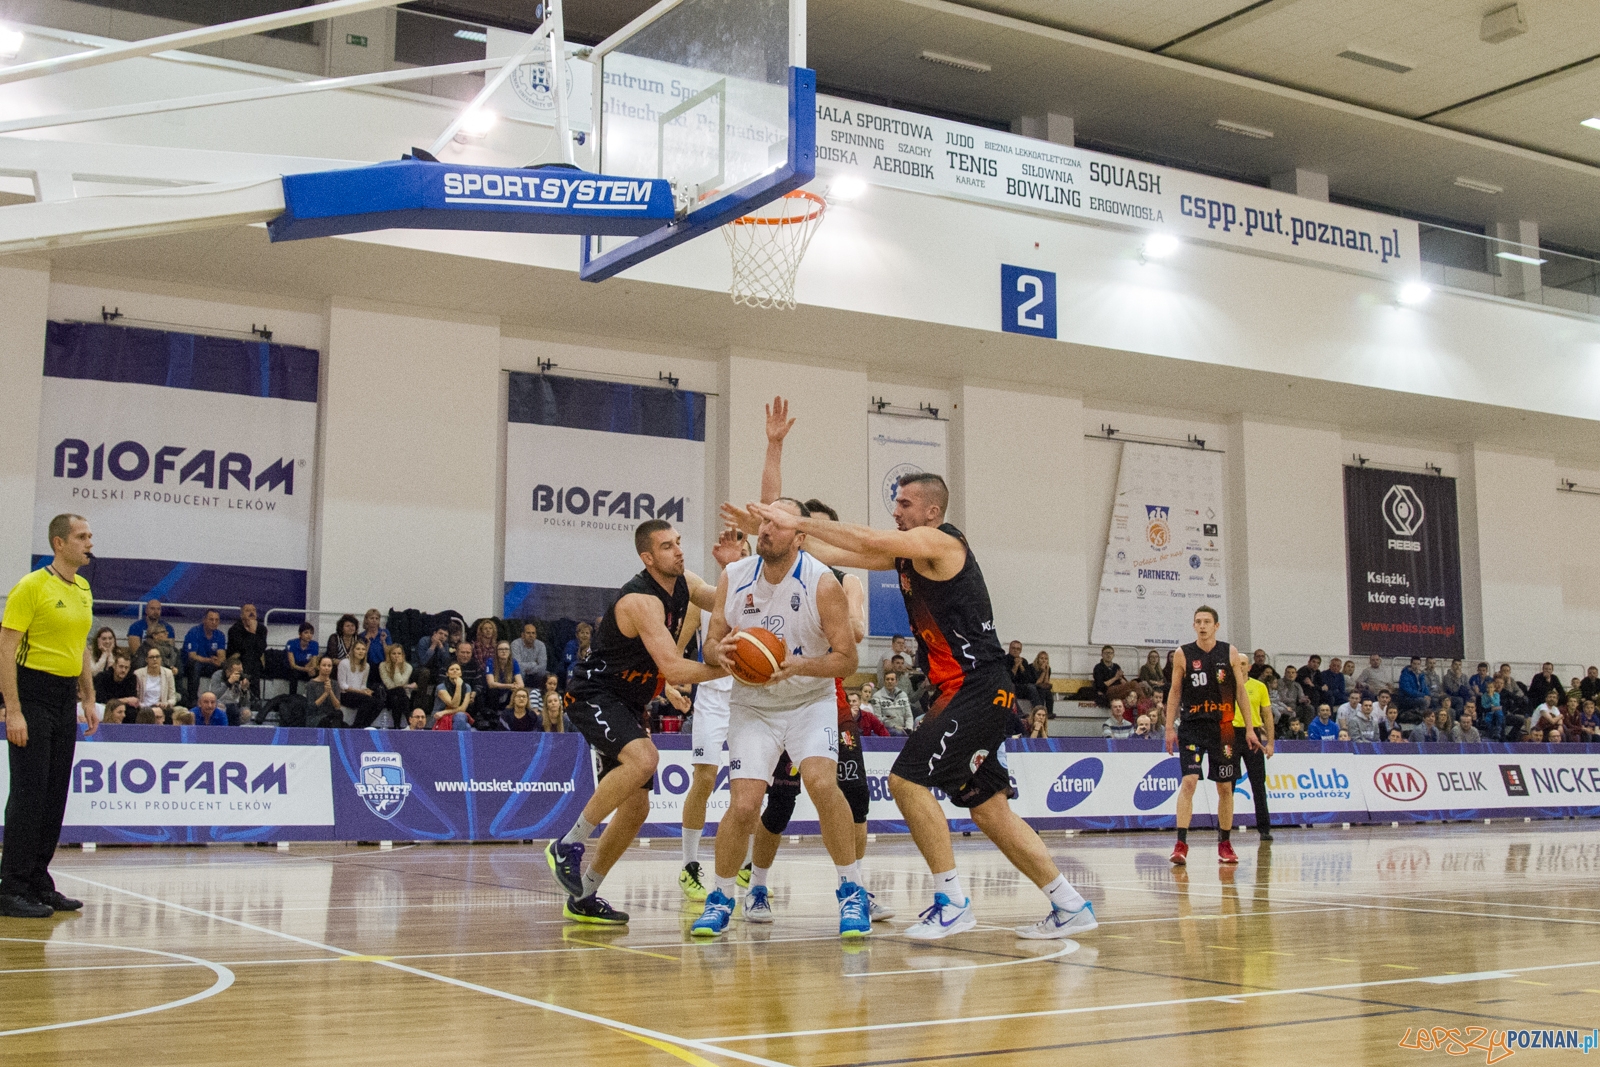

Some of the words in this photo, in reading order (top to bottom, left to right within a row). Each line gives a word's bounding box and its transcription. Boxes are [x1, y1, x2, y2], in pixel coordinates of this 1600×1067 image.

[603, 72, 664, 94] entrum
[816, 105, 852, 125] HALA
[856, 113, 933, 141] SPORTOWA
[831, 130, 884, 150] SPININNG
[898, 143, 932, 157] SZACHY
[945, 132, 974, 149] JUDO
[873, 156, 934, 179] AEROBIK
[946, 151, 997, 177] TENIS
[1015, 148, 1081, 168] LEKKOATLETYCZNA
[956, 175, 986, 188] KARATE
[1022, 164, 1073, 184] SIŁOWNIA
[1089, 162, 1161, 194] SQUASH
[1006, 177, 1080, 208] BOWLING
[1089, 196, 1164, 222] ERGOWIOSŁA
[1180, 194, 1401, 263] cspp.put.poznan.pl
[1017, 274, 1044, 329] 2
[53, 438, 295, 496] BIOFARM
[72, 487, 124, 500] POLSKI
[134, 490, 219, 507] PRODUCENT
[228, 497, 277, 511] LEKÓW
[532, 484, 684, 522] BIOFARM
[543, 517, 576, 527] POLSKI
[581, 520, 635, 531] PRODUCENT
[1388, 539, 1421, 551] REBIS
[1138, 568, 1181, 581] PARTNERZY:
[1367, 571, 1410, 587] Książki,
[1368, 591, 1397, 604] które
[1399, 594, 1416, 607] się
[1418, 595, 1445, 608] czyta
[761, 615, 784, 639] 12
[1361, 621, 1455, 637] www.rebis.com.pl
[1191, 672, 1208, 687] 30
[72, 758, 288, 795] BIOFARM
[837, 760, 859, 781] 92
[1218, 765, 1233, 778] 30
[1265, 768, 1349, 790] unclub
[1531, 768, 1600, 793] NICKE
[356, 784, 410, 795] BASKET
[434, 778, 575, 794] www.basket.poznan.pl
[867, 776, 894, 801] BG
[1053, 775, 1095, 792] atrem
[1140, 774, 1178, 791] atrem
[1381, 772, 1421, 792] KIA
[1437, 771, 1488, 791] DELIK
[91, 801, 137, 810] POLSKI
[145, 801, 222, 810] PRODUCENT
[229, 799, 272, 810] LEKÓW
[649, 801, 678, 809] OLSKI
[1265, 791, 1295, 799] iuro
[1300, 790, 1351, 800] podróży
